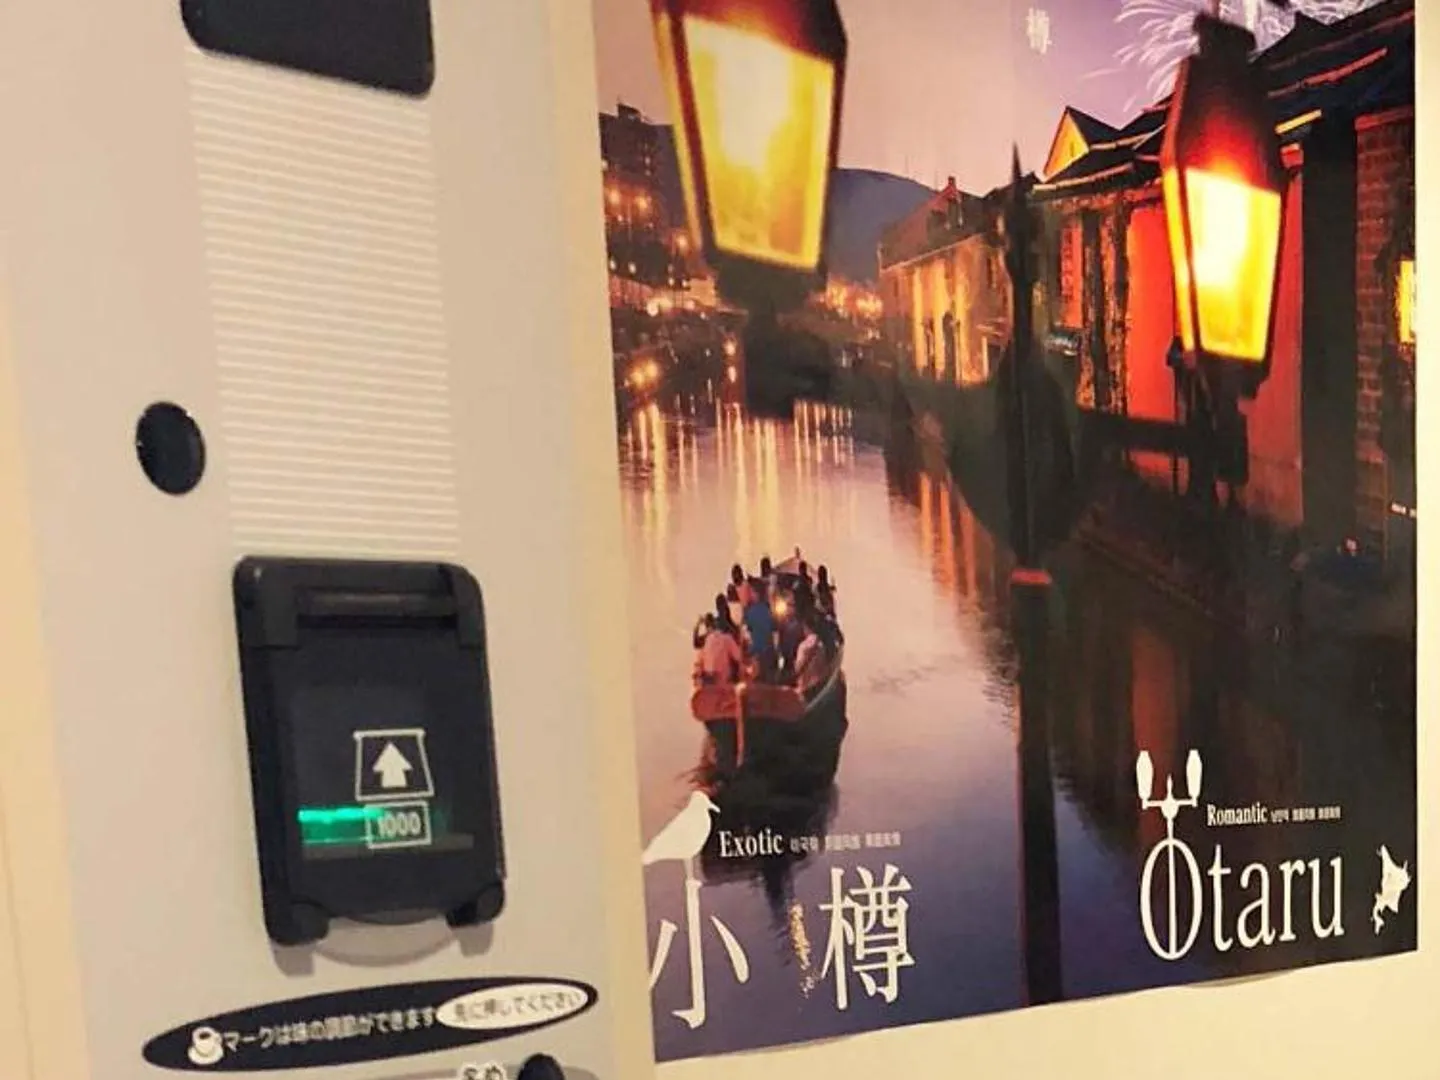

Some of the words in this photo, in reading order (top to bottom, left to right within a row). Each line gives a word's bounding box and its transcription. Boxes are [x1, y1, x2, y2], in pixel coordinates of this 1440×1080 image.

[377, 811, 421, 838] 1000
[1206, 802, 1268, 826] Romantic
[718, 828, 784, 857] Exotic
[1139, 838, 1344, 960] Otaru
